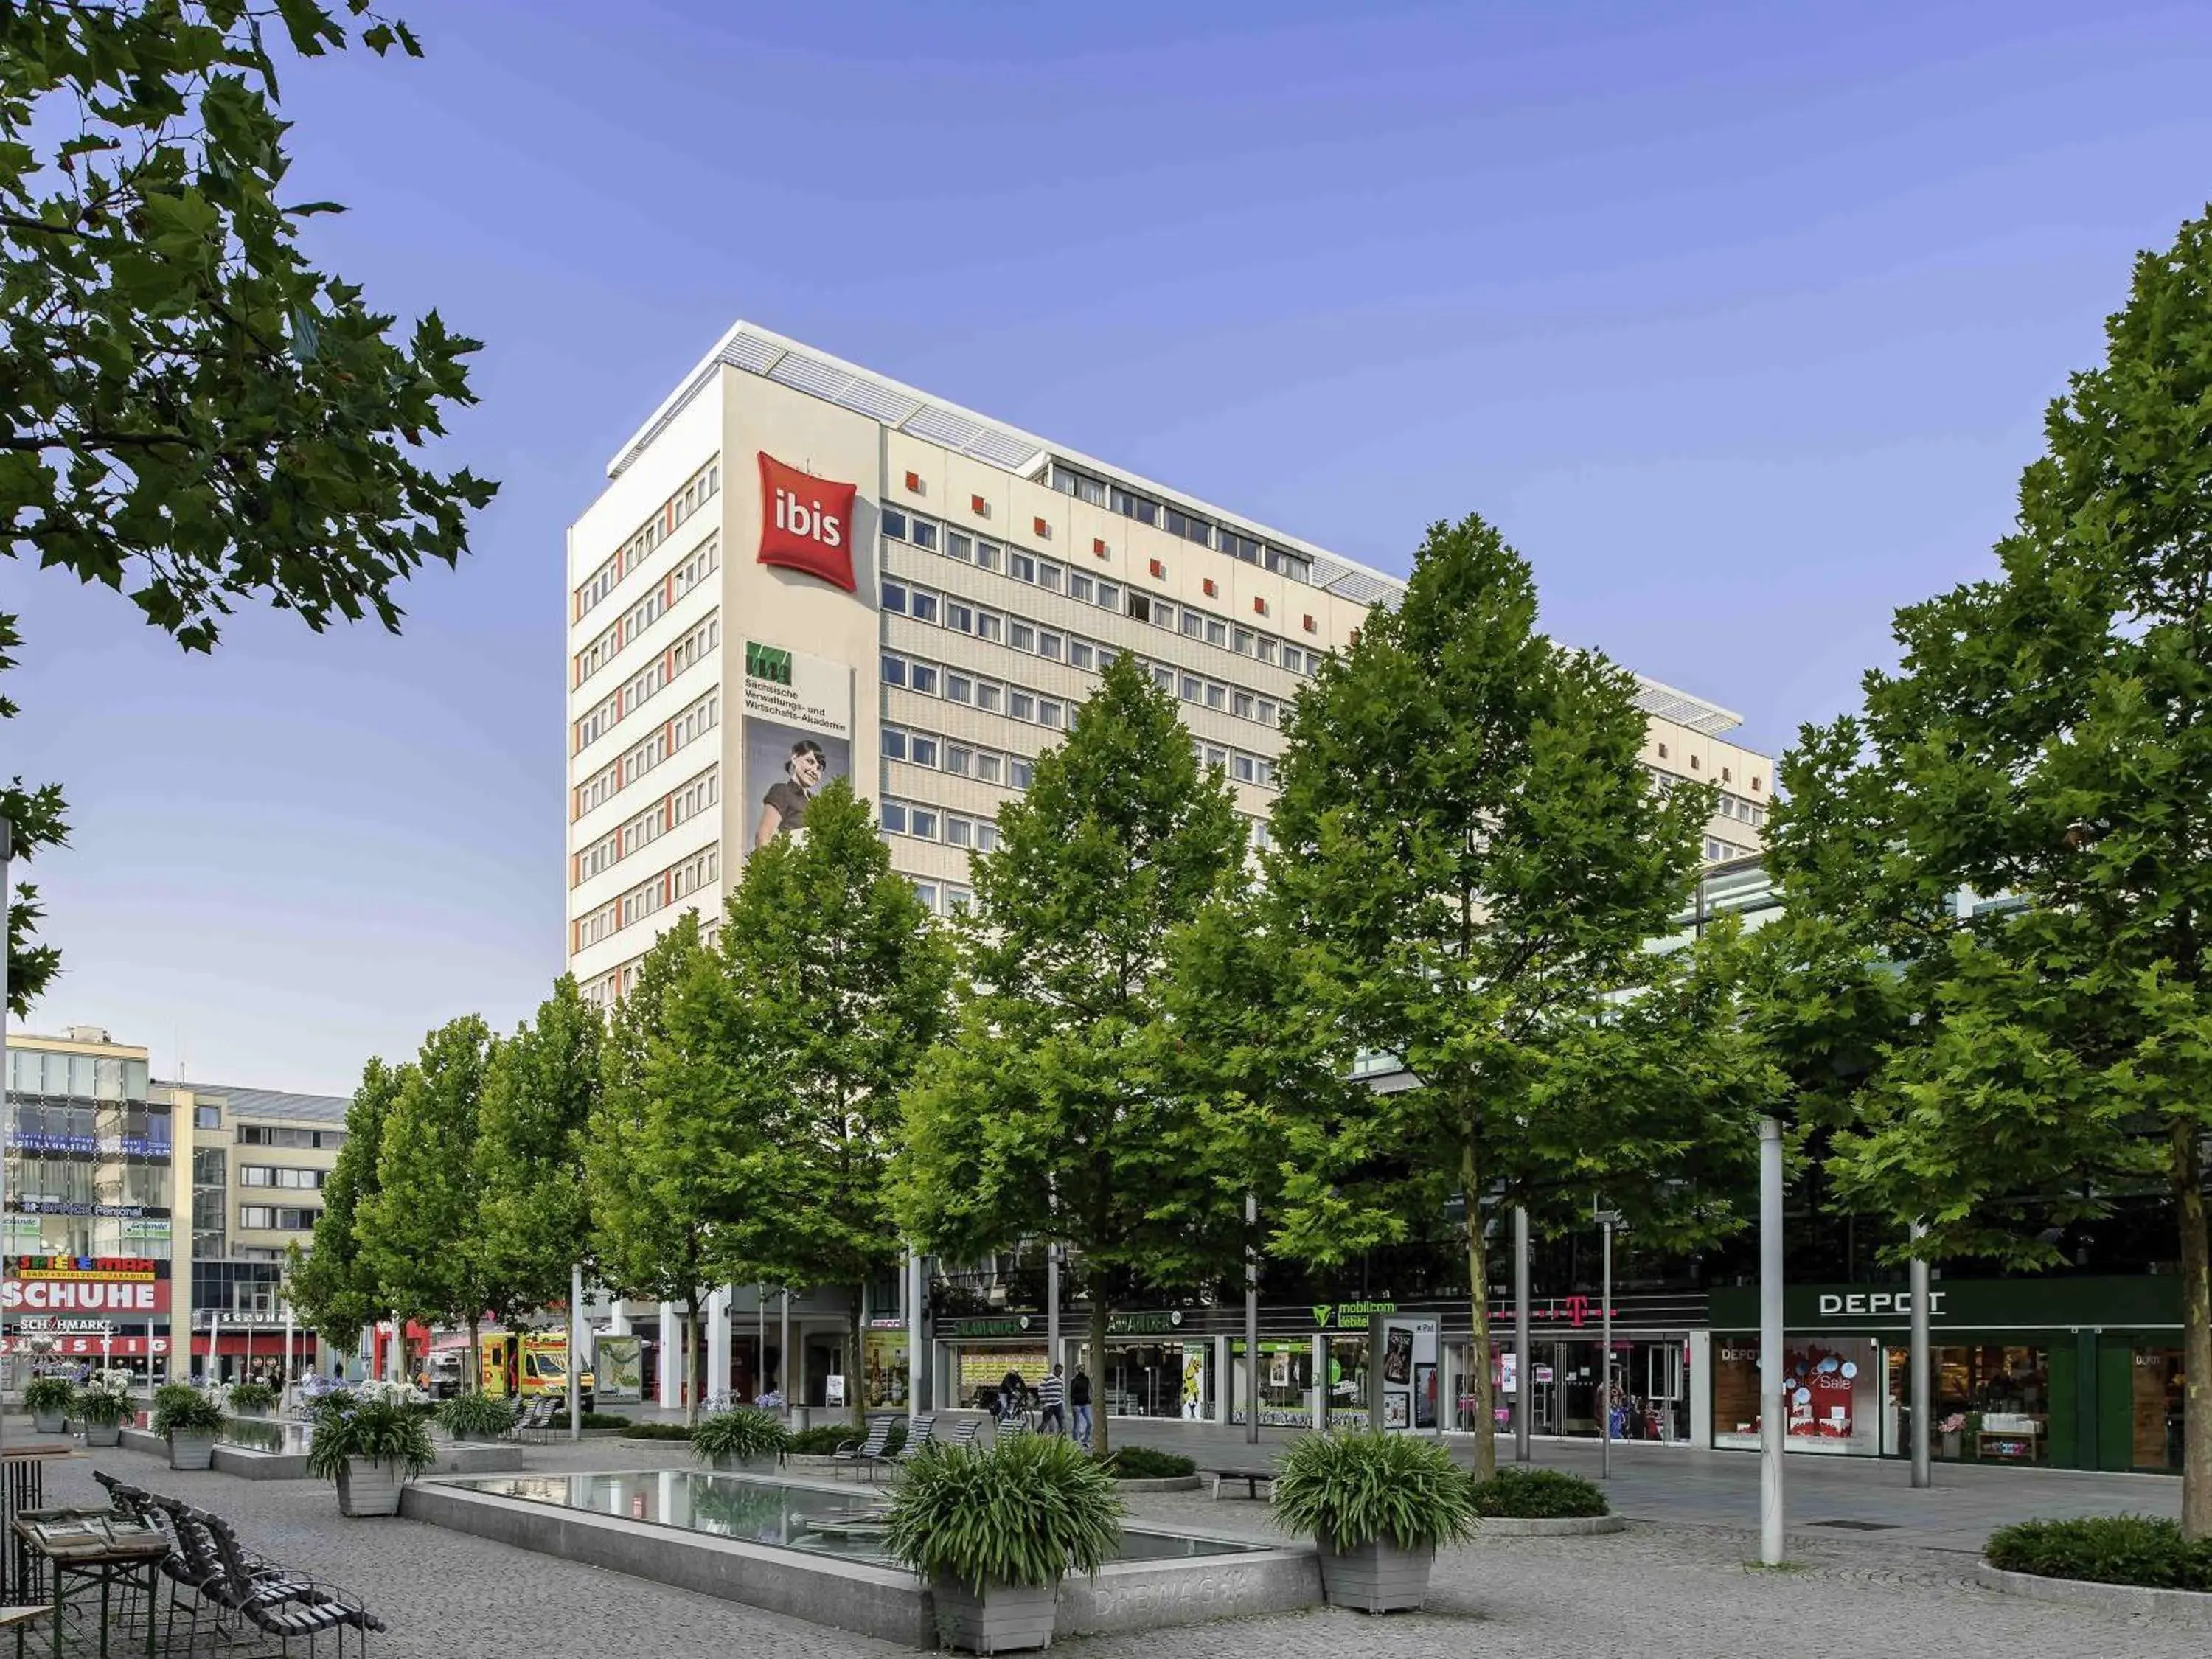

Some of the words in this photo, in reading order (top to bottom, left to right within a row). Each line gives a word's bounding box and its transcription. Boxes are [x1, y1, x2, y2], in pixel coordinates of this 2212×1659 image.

[776, 487, 840, 546] ibis
[807, 707, 826, 716] und
[20, 1256, 92, 1270] SPIELE
[2, 1281, 156, 1308] SCHUHE
[1338, 1300, 1395, 1313] mobilcom
[1819, 1292, 1946, 1314] DEPOT
[1820, 1375, 1852, 1390] Sale
